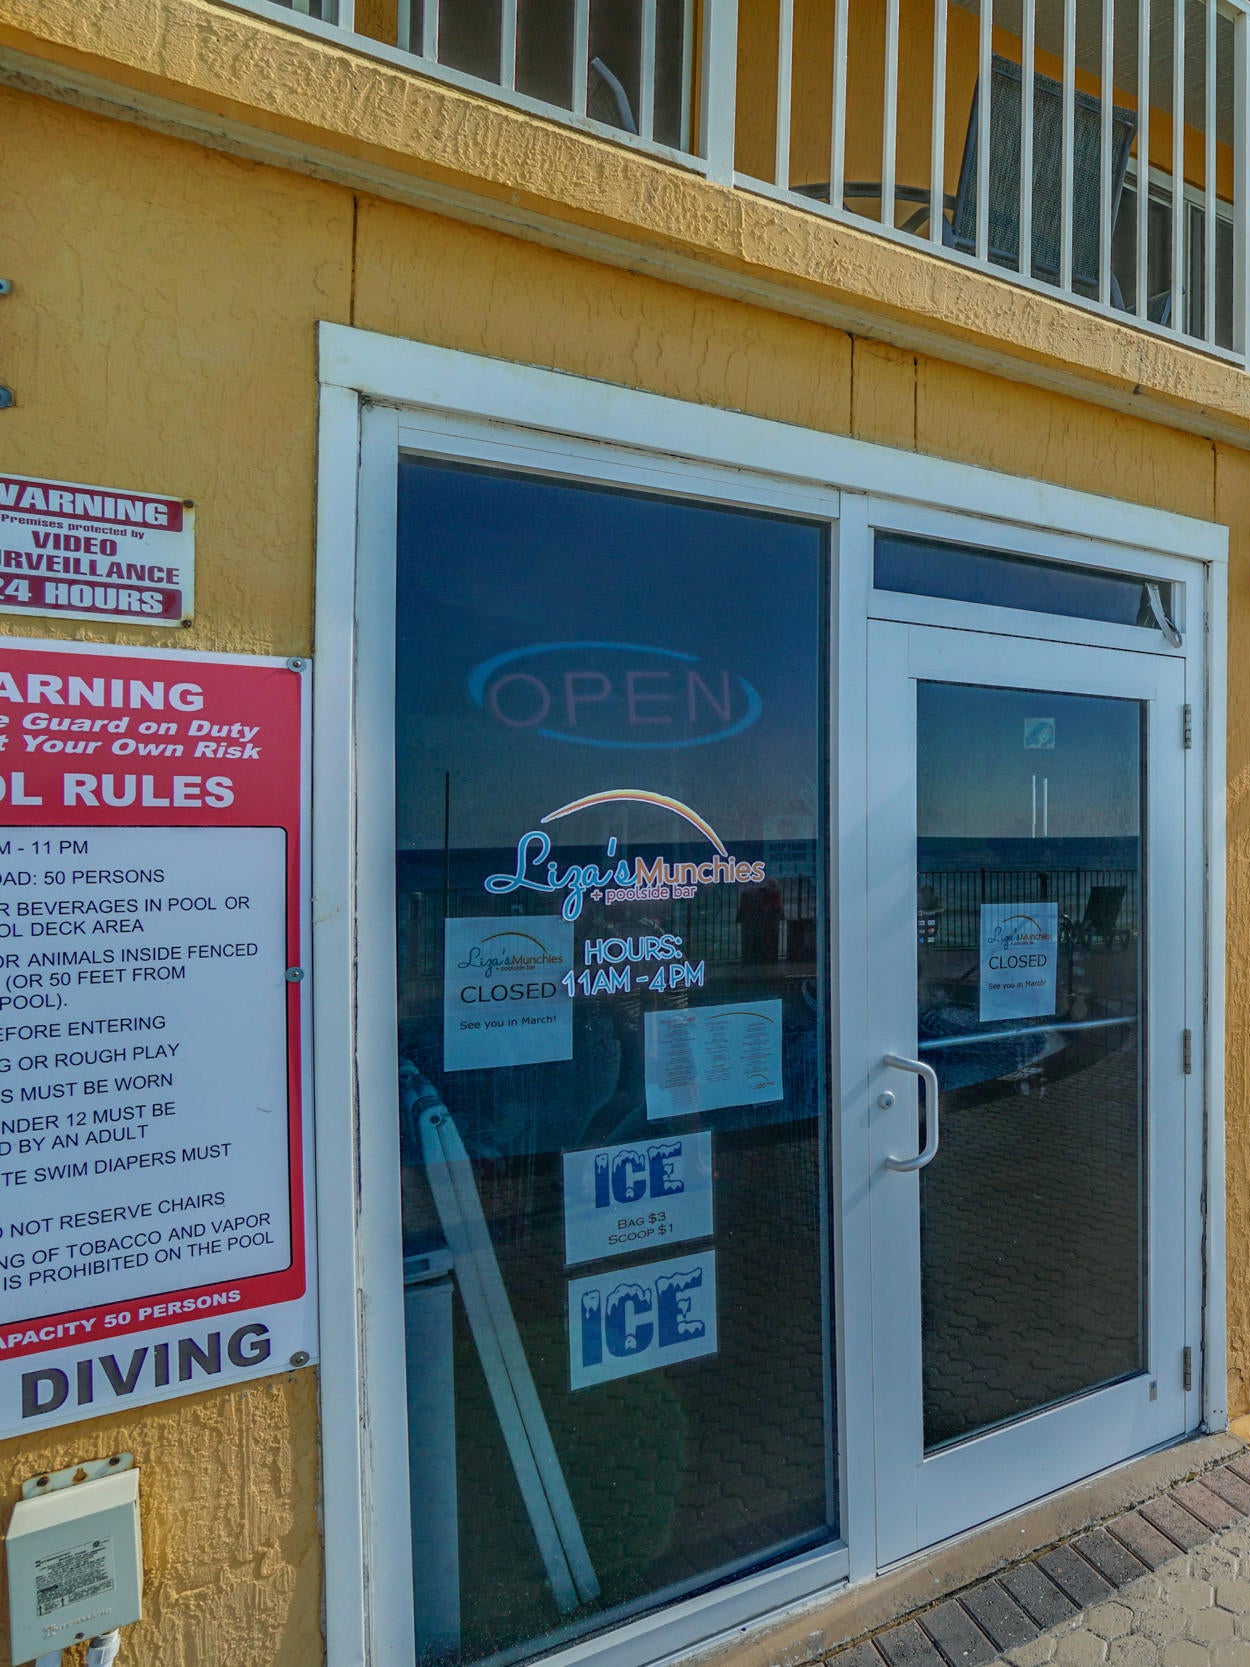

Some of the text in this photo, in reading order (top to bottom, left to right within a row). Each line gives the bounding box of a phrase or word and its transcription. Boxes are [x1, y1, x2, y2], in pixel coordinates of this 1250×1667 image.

[1, 514, 145, 540] Premises protected by
[31, 530, 118, 556] VIDEO
[0, 550, 180, 585] RVEILLANCE
[0, 578, 164, 614] 4 HOURS
[488, 669, 731, 728] OPEN
[22, 712, 129, 734] Guard
[138, 721, 176, 736] on
[188, 719, 260, 742] Duty
[22, 735, 103, 754] Your
[111, 738, 184, 758] Own
[194, 741, 261, 760] Risk
[0, 771, 235, 809] L RULES
[32, 841, 50, 855] 11
[59, 840, 88, 854] PM
[0, 869, 165, 886] AD: 50 PERSONS
[636, 855, 765, 884] Munchies
[17, 899, 138, 916] BEVERAGES
[145, 899, 162, 912] IN
[168, 898, 216, 911] POOL
[225, 896, 250, 910] OR
[605, 885, 669, 905] poolside
[672, 884, 697, 899] bar
[31, 921, 86, 937] DECK
[92, 919, 144, 934] AREA
[28, 950, 115, 967] ANIMALS
[121, 946, 182, 962] INSIDE
[188, 943, 258, 959] FENCED
[511, 954, 564, 965] Munchies
[584, 934, 683, 965] HOURS:
[989, 954, 1047, 970] CLOSED
[6, 966, 185, 993] (OR 50 FEET FROM
[562, 966, 631, 997] 11AM
[650, 961, 705, 992] 4PM
[0, 993, 68, 1011] POOL).
[460, 982, 557, 1004] CLOSED
[68, 1016, 166, 1036] ENTERING
[460, 1016, 556, 1030] See you in March!
[18, 1055, 48, 1071] OR
[55, 1048, 126, 1068] ROUGH
[133, 1043, 180, 1060] PLAY
[21, 1082, 77, 1102] MUST
[84, 1079, 108, 1095] BE
[115, 1073, 173, 1091] WORN
[67, 1112, 87, 1127] 12
[93, 1105, 146, 1124] MUST
[152, 1102, 176, 1116] BE
[19, 1137, 46, 1154] BY
[52, 1133, 78, 1150] AN
[85, 1125, 148, 1145] ADULT
[34, 1162, 88, 1182] SWIM
[95, 1150, 176, 1174] DIAPERS
[182, 1143, 232, 1162] MUST
[594, 1141, 685, 1209] ICE
[10, 1218, 54, 1238] NOT
[60, 1203, 153, 1230] RESERVE
[158, 1192, 226, 1213] CHAIRS
[648, 1211, 666, 1225] $3
[32, 1248, 60, 1266] OF
[66, 1231, 162, 1259] TOBACCO
[168, 1223, 206, 1242] AND
[211, 1213, 271, 1234] VAPOR
[658, 1223, 673, 1236] $1
[3, 1231, 275, 1292] IS PROHIBITED ON THE POOL
[0, 1289, 241, 1350] PACITY 50 PERSONS
[581, 1266, 705, 1367] ICE
[21, 1323, 272, 1419] DIVING
